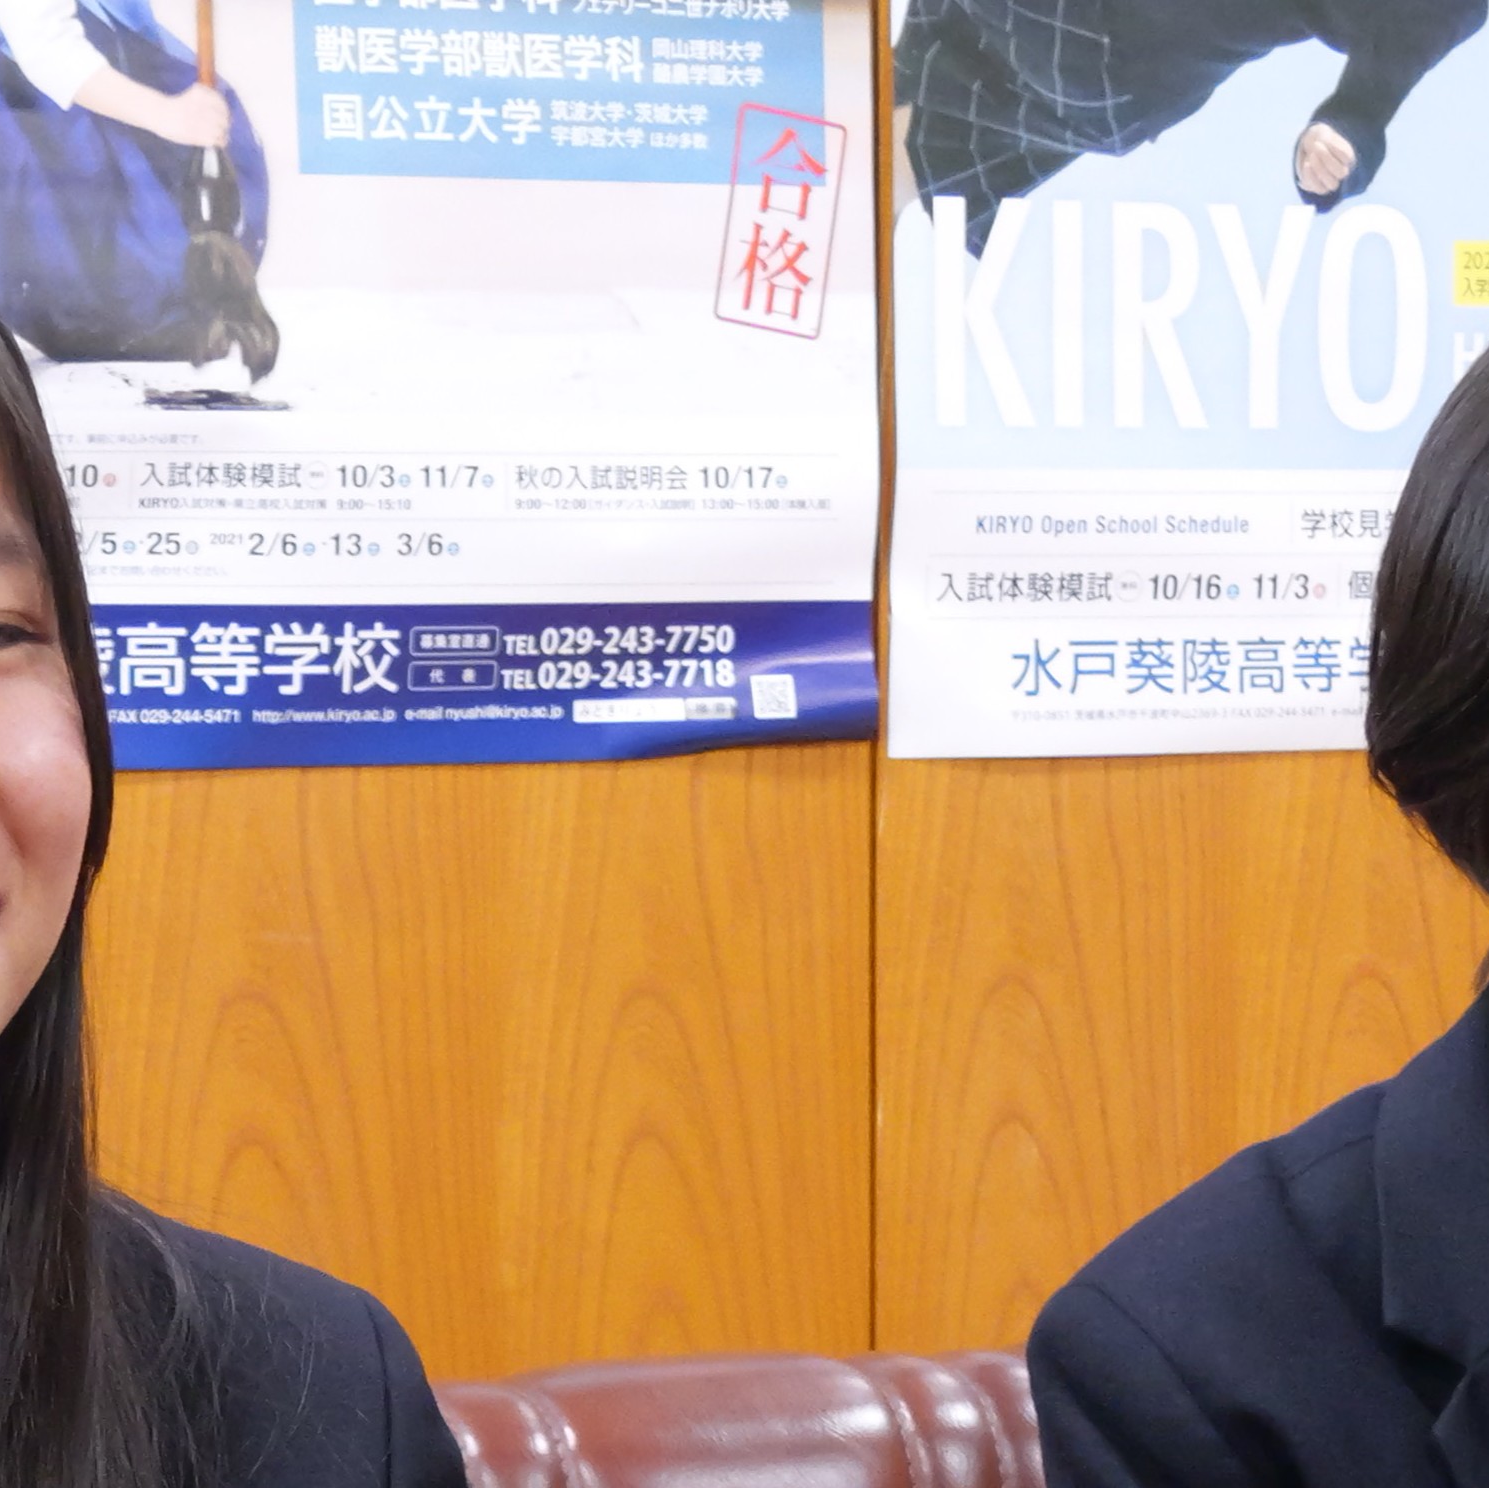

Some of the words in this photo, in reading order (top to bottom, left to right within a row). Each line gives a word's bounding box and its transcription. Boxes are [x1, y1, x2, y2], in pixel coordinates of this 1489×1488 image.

[314, 25, 644, 83] 獣医学部獣医学科
[321, 92, 542, 146] 国公立大学
[549, 125, 645, 148] 宇都宮大学
[736, 127, 829, 322] 合格
[932, 195, 1429, 433] KIRYO
[140, 461, 302, 489] 入試体験模試
[515, 464, 688, 491] 秋の入試説明会
[975, 515, 1034, 535] KIRYO
[1040, 516, 1089, 538] Open
[1095, 515, 1158, 535] School
[1165, 514, 1250, 535] Schedule
[936, 572, 1113, 603] 入試体験模試
